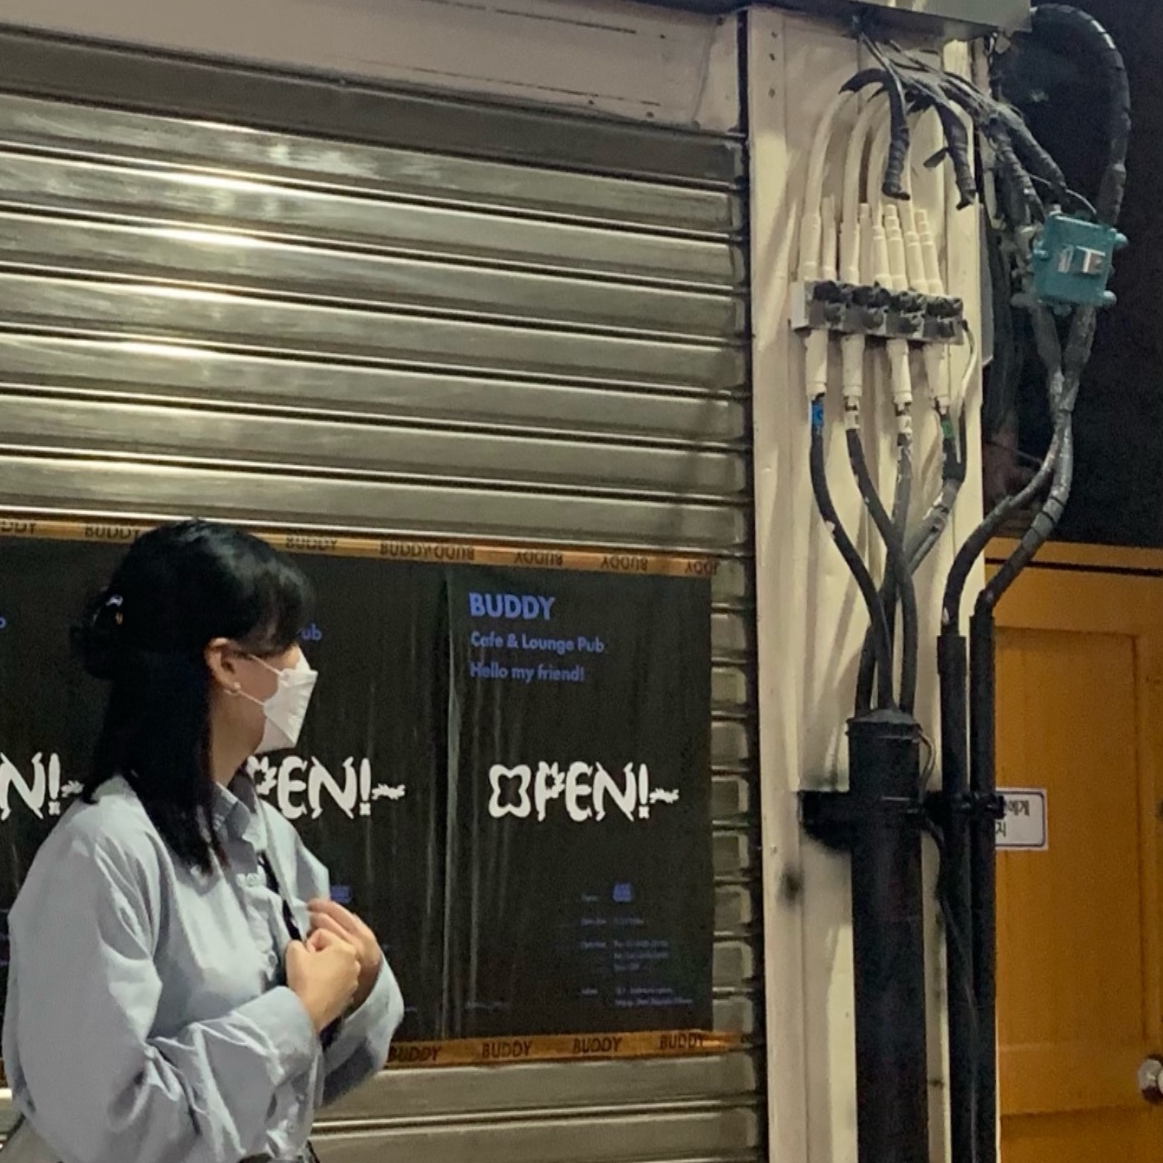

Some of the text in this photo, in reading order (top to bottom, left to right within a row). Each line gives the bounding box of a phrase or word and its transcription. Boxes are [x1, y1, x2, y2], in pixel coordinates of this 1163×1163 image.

[469, 592, 556, 620] BUDDY
[300, 622, 323, 641] ub
[471, 630, 605, 656] Cafe & Lounge Pub
[470, 661, 586, 684] Hello my friend!
[481, 1040, 534, 1060] BUDDY
[572, 1036, 623, 1055] BUDDY
[659, 1033, 705, 1050] BUDDY
